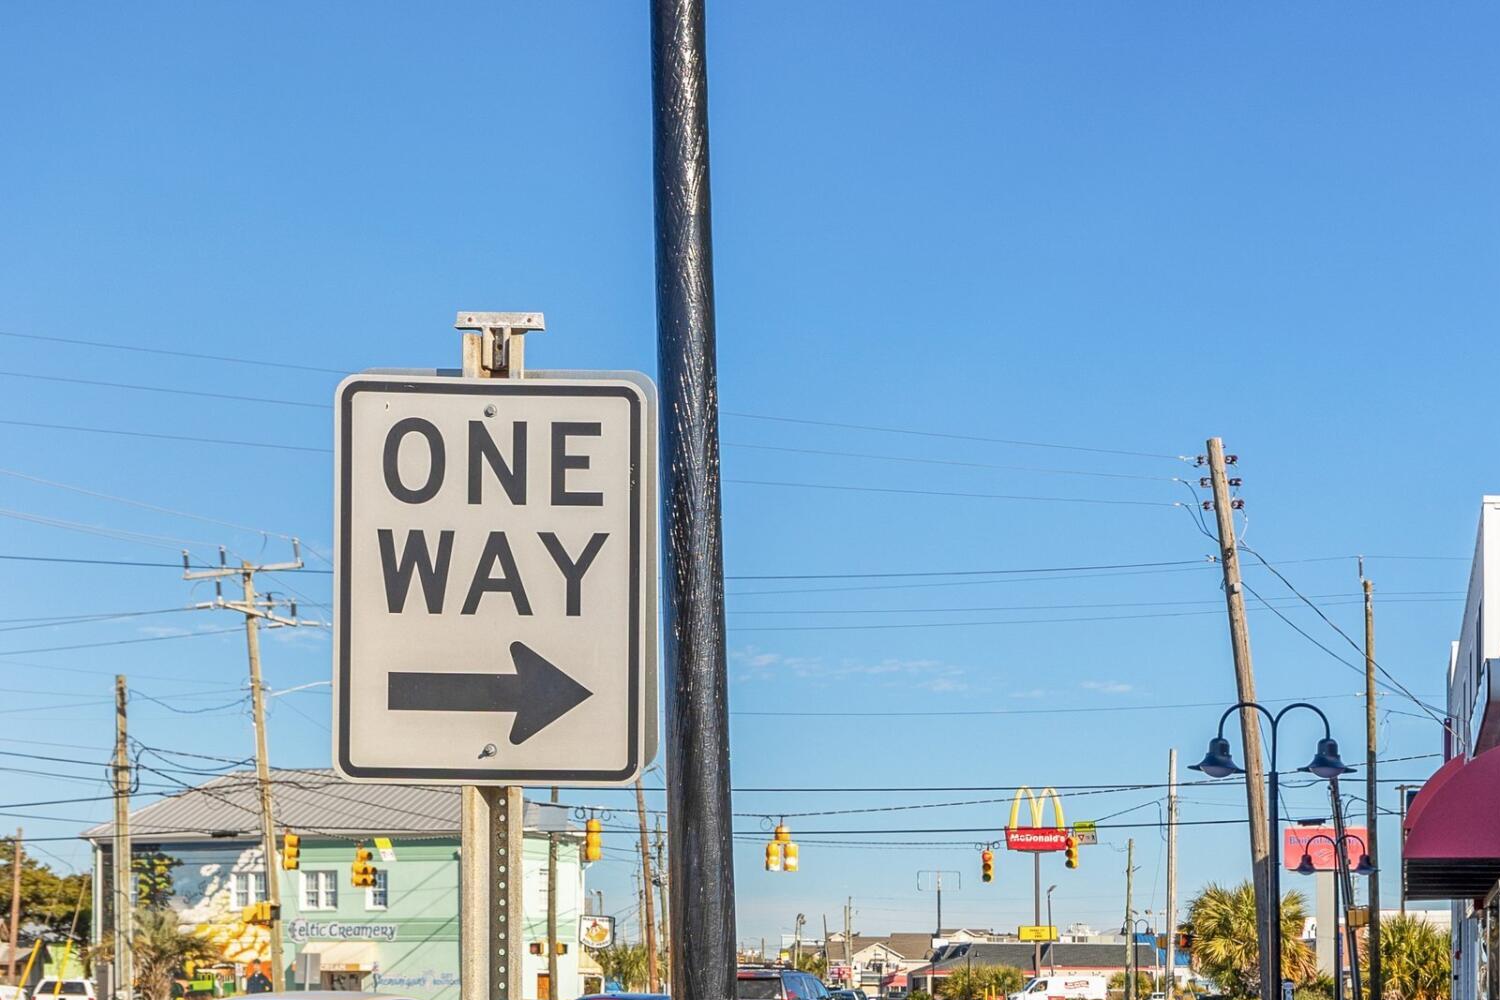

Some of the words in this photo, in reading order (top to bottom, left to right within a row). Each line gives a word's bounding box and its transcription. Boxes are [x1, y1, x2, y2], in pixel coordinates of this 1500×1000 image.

[382, 416, 604, 507] ONE
[376, 528, 611, 617] WAY
[1009, 833, 1065, 843] McDonald's
[328, 923, 396, 940] Creamery
